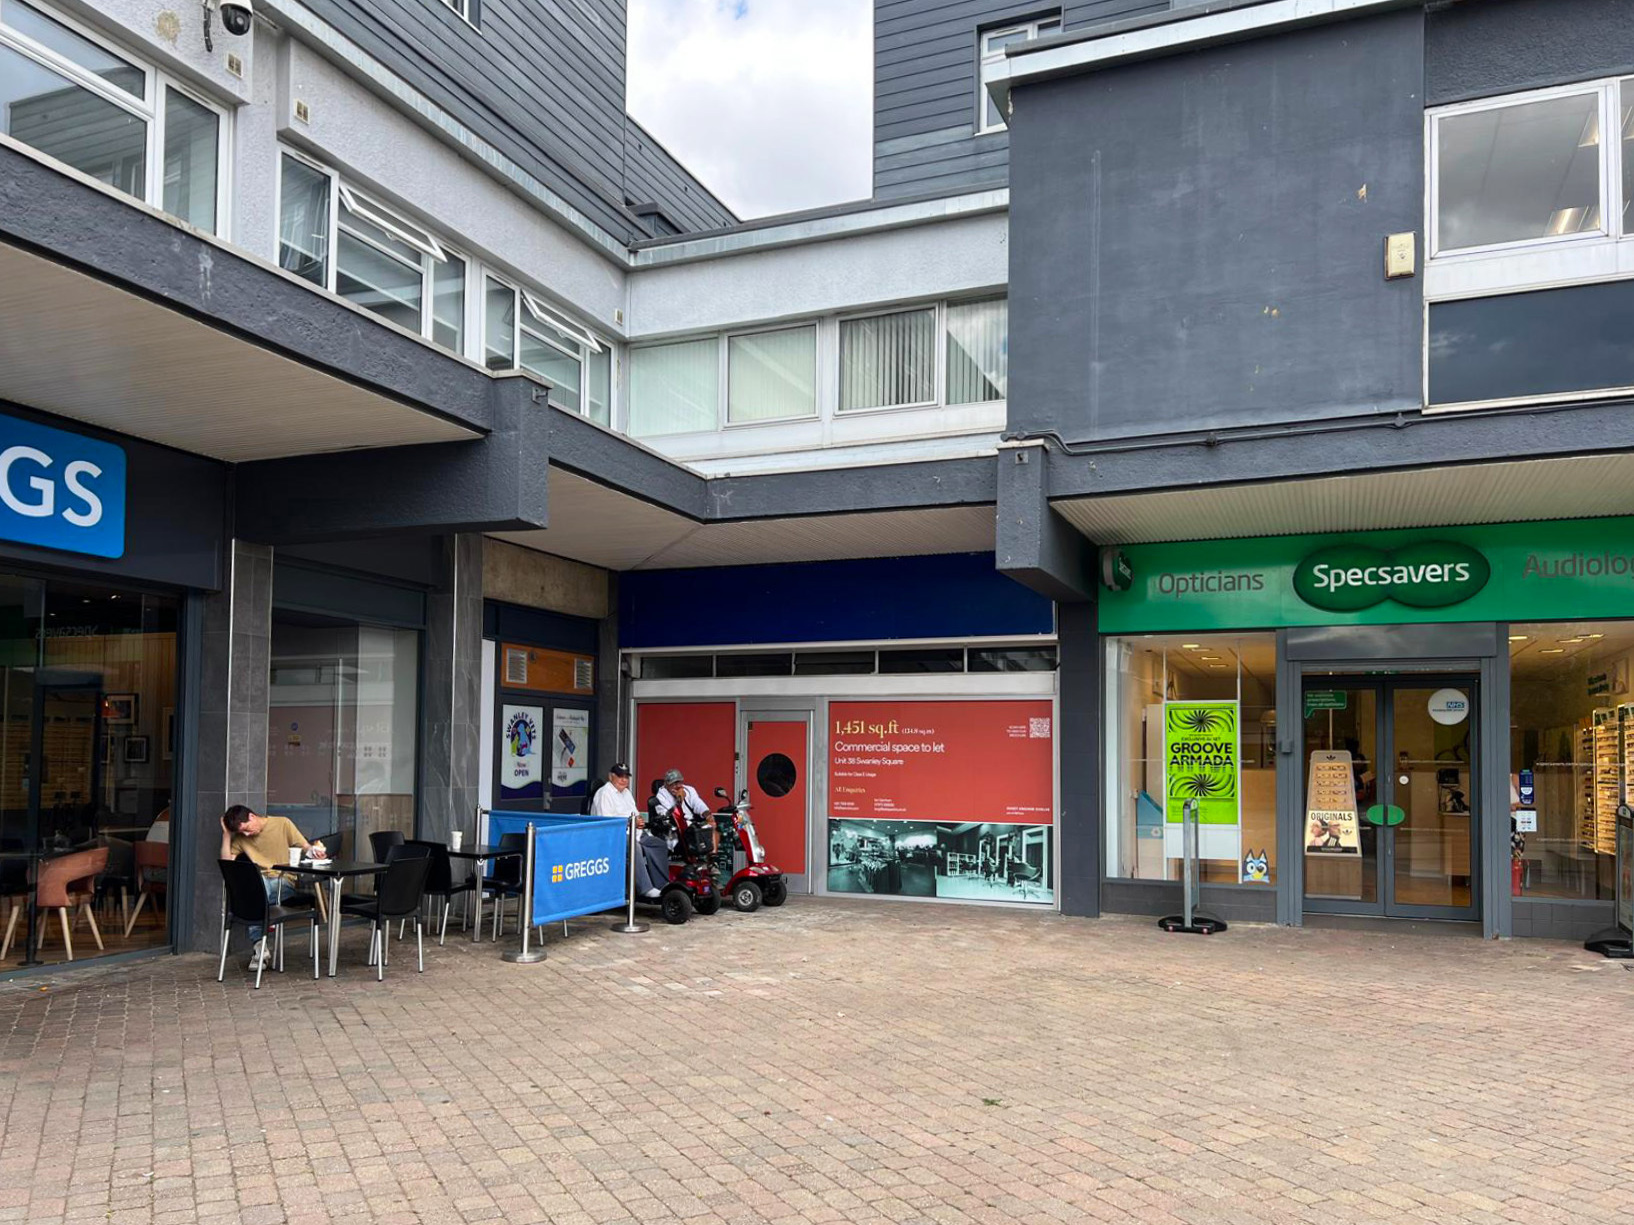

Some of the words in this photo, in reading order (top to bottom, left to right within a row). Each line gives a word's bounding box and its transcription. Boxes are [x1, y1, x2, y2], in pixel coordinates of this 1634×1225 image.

[0, 446, 102, 527] GS
[1522, 550, 1634, 579] Audiolo
[1158, 571, 1264, 598] Opticians
[1313, 562, 1469, 592] Specsavers
[506, 712, 529, 739] SWANLEY
[835, 720, 865, 735] 1,451
[868, 720, 899, 739] sq.ft
[835, 741, 890, 752] Commercial
[892, 744, 920, 754] space
[921, 743, 931, 752] to
[933, 742, 945, 752] let
[1170, 742, 1233, 754] GROOVE
[857, 758, 880, 766] Swanley
[881, 758, 904, 766] Square
[1170, 755, 1234, 766] ARMADA
[514, 769, 529, 777] OPEN
[1310, 812, 1352, 821] ORIGINALS
[565, 857, 610, 880] GREGGS
